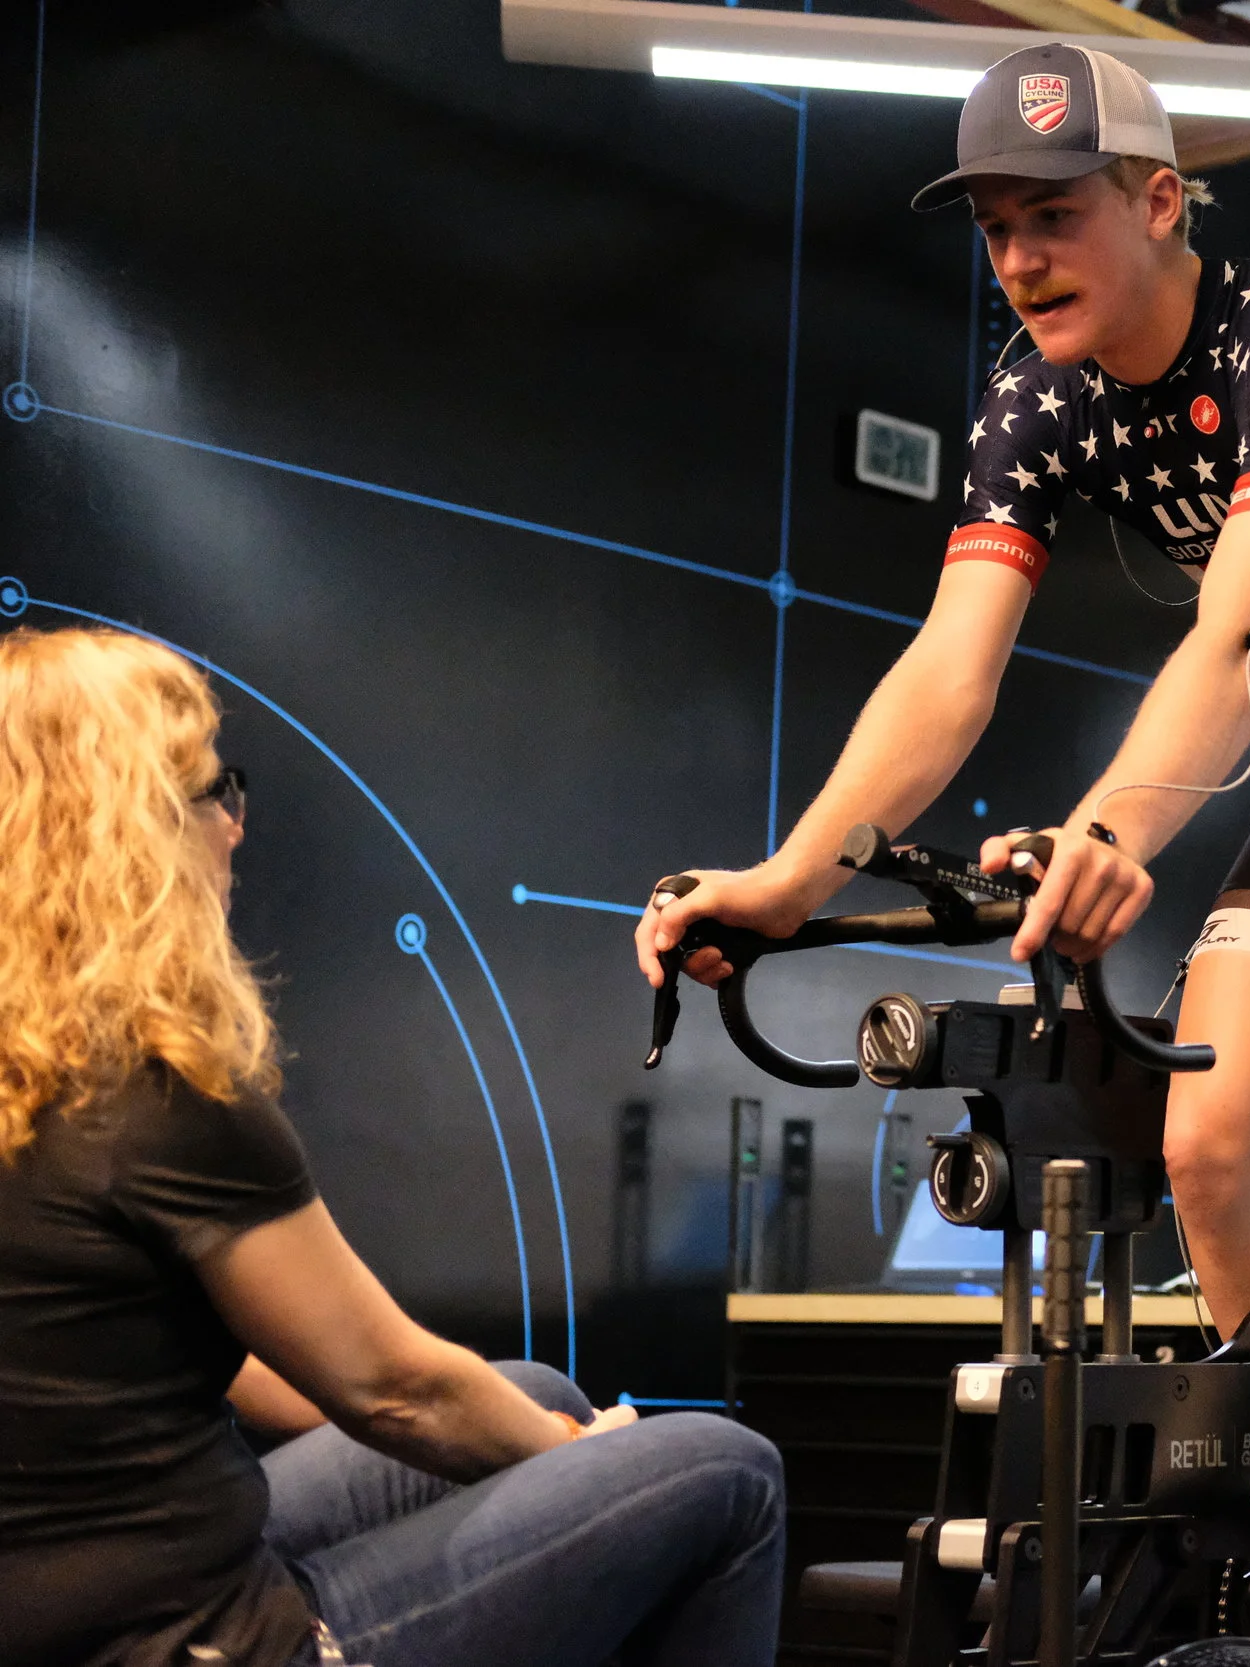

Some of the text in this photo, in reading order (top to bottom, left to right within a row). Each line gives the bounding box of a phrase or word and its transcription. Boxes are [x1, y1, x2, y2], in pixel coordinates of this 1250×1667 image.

[1025, 90, 1064, 98] CYCLING
[1026, 77, 1064, 92] USA
[948, 539, 1035, 567] SHIMANO
[1170, 1433, 1227, 1469] RETÜL
